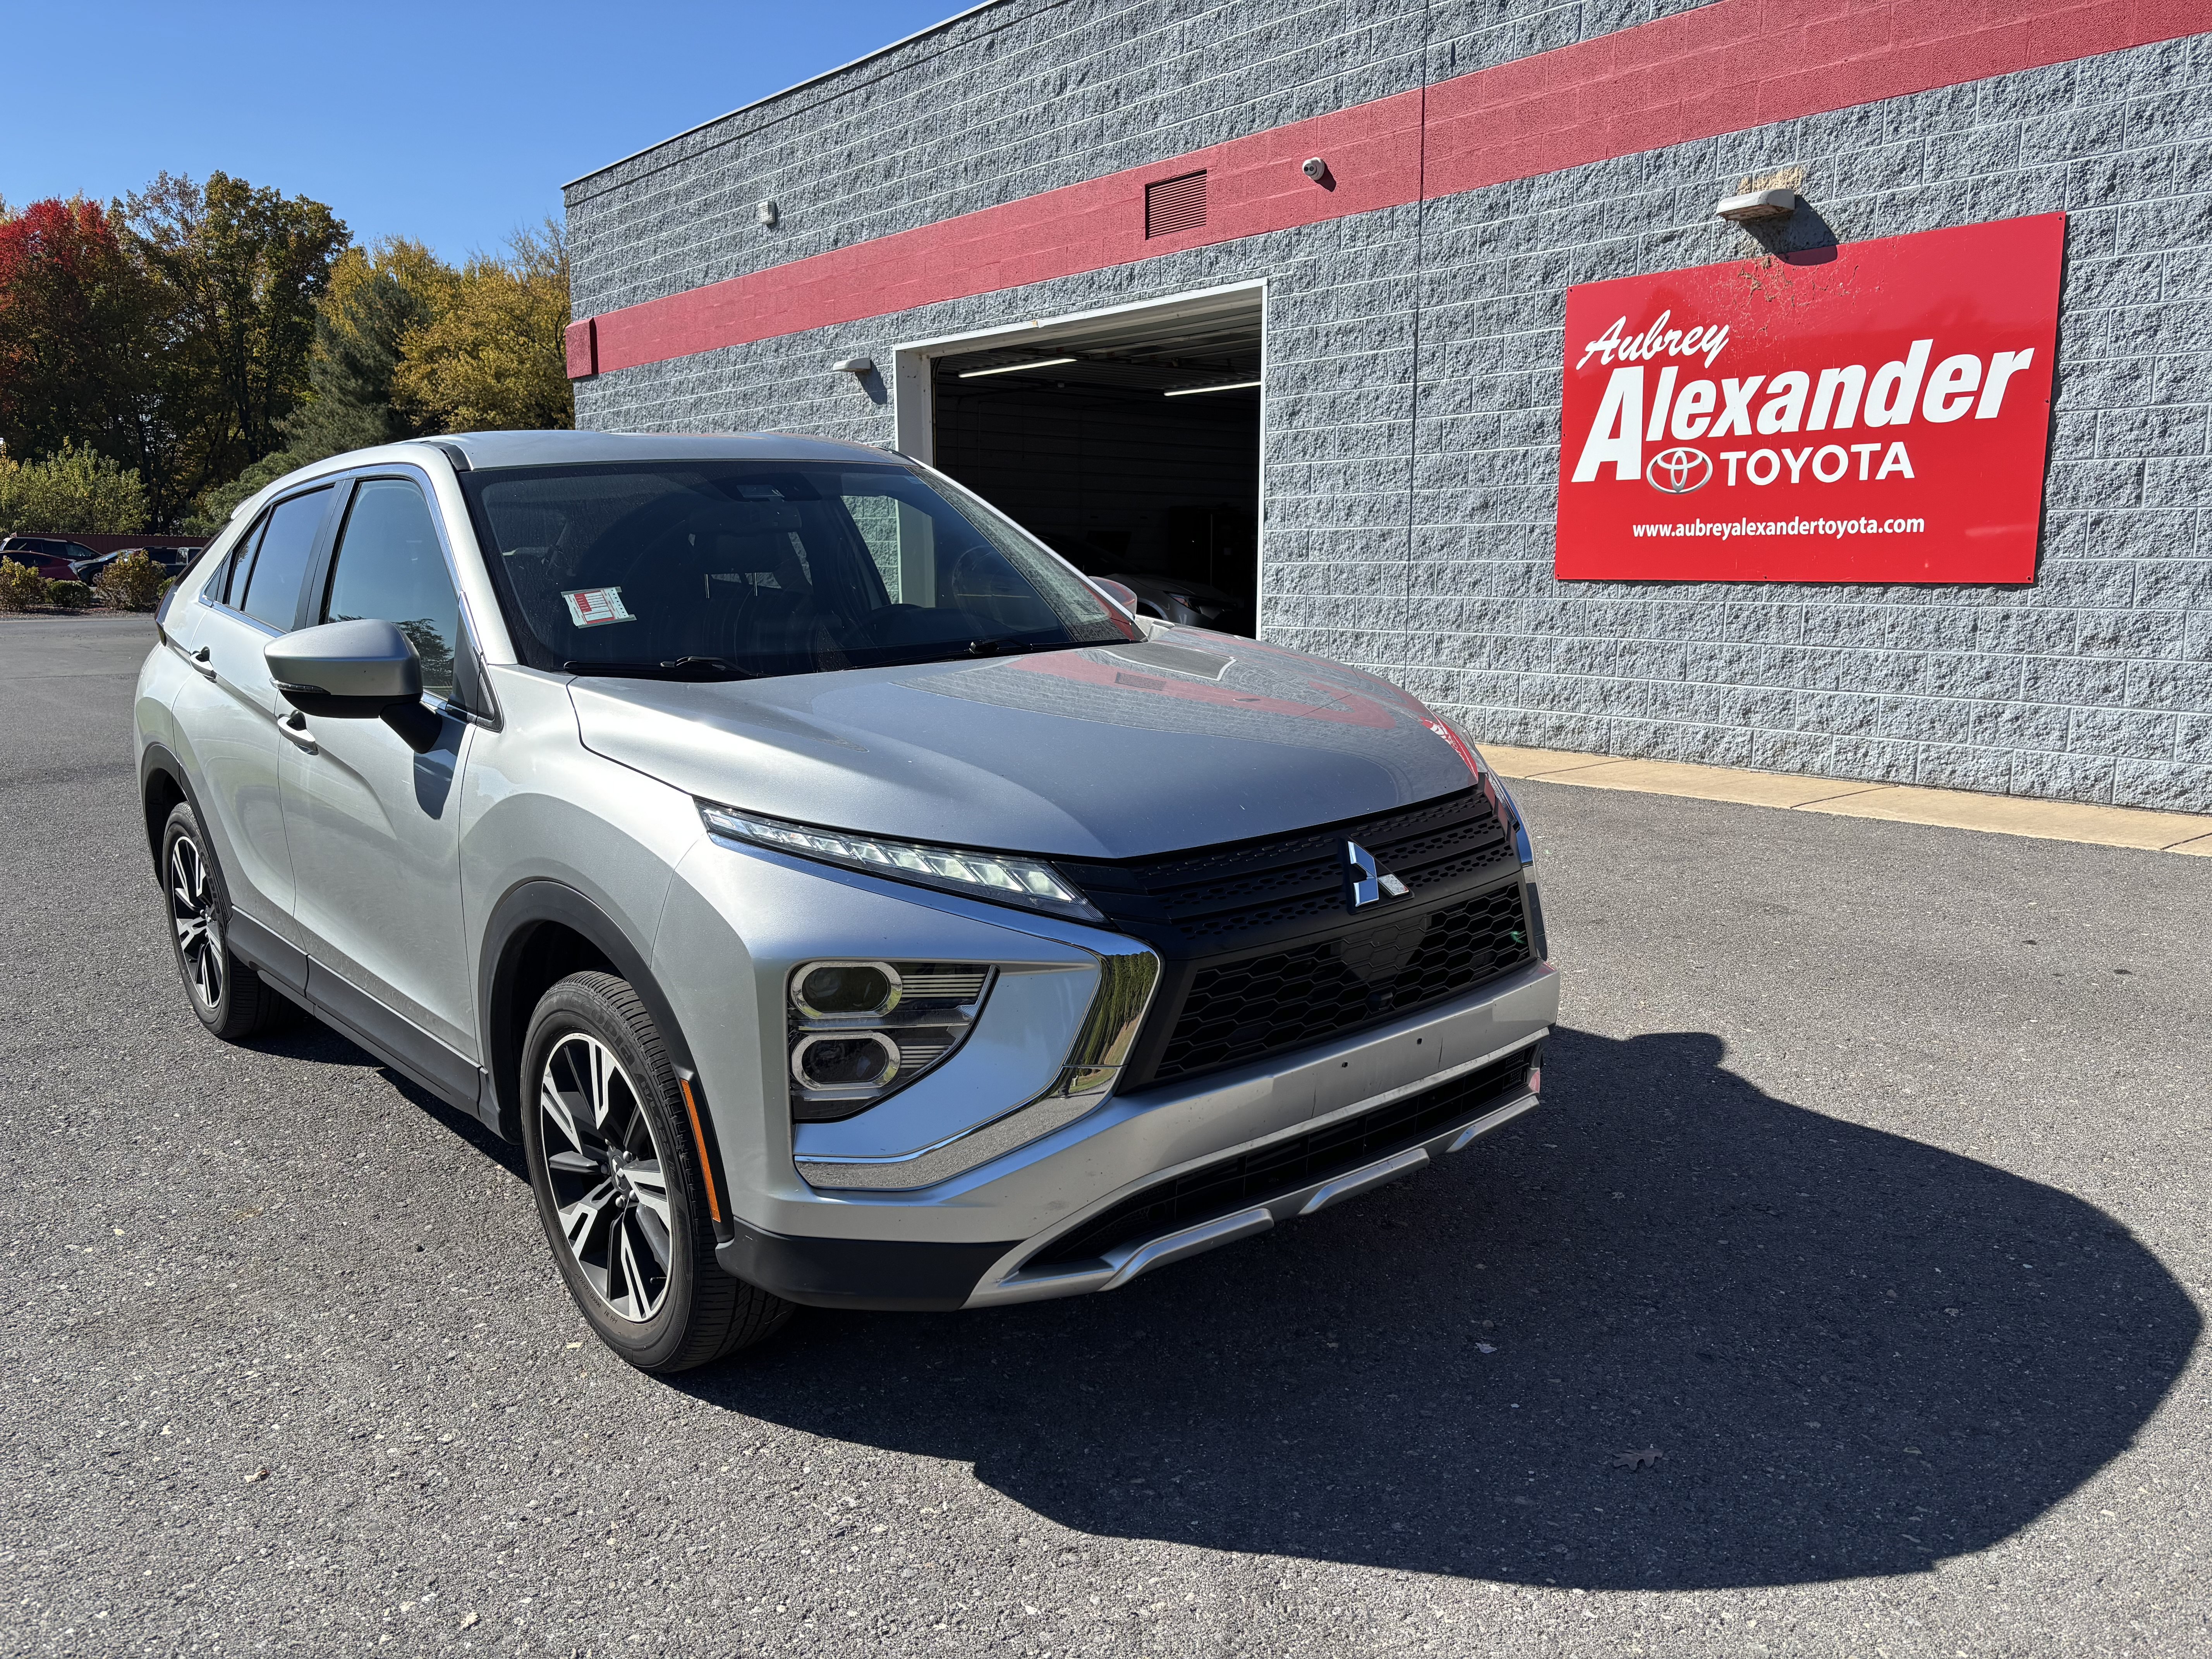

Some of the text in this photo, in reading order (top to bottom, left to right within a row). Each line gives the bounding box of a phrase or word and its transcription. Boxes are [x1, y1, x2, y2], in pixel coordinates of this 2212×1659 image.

[1576, 310, 1729, 370] Aubrey
[1572, 339, 2035, 482] Alexander
[1720, 442, 1915, 486] TOYOTA
[1633, 516, 1924, 540] www.aubreyalexandertoyota.com
[655, 1116, 671, 1156] 422
